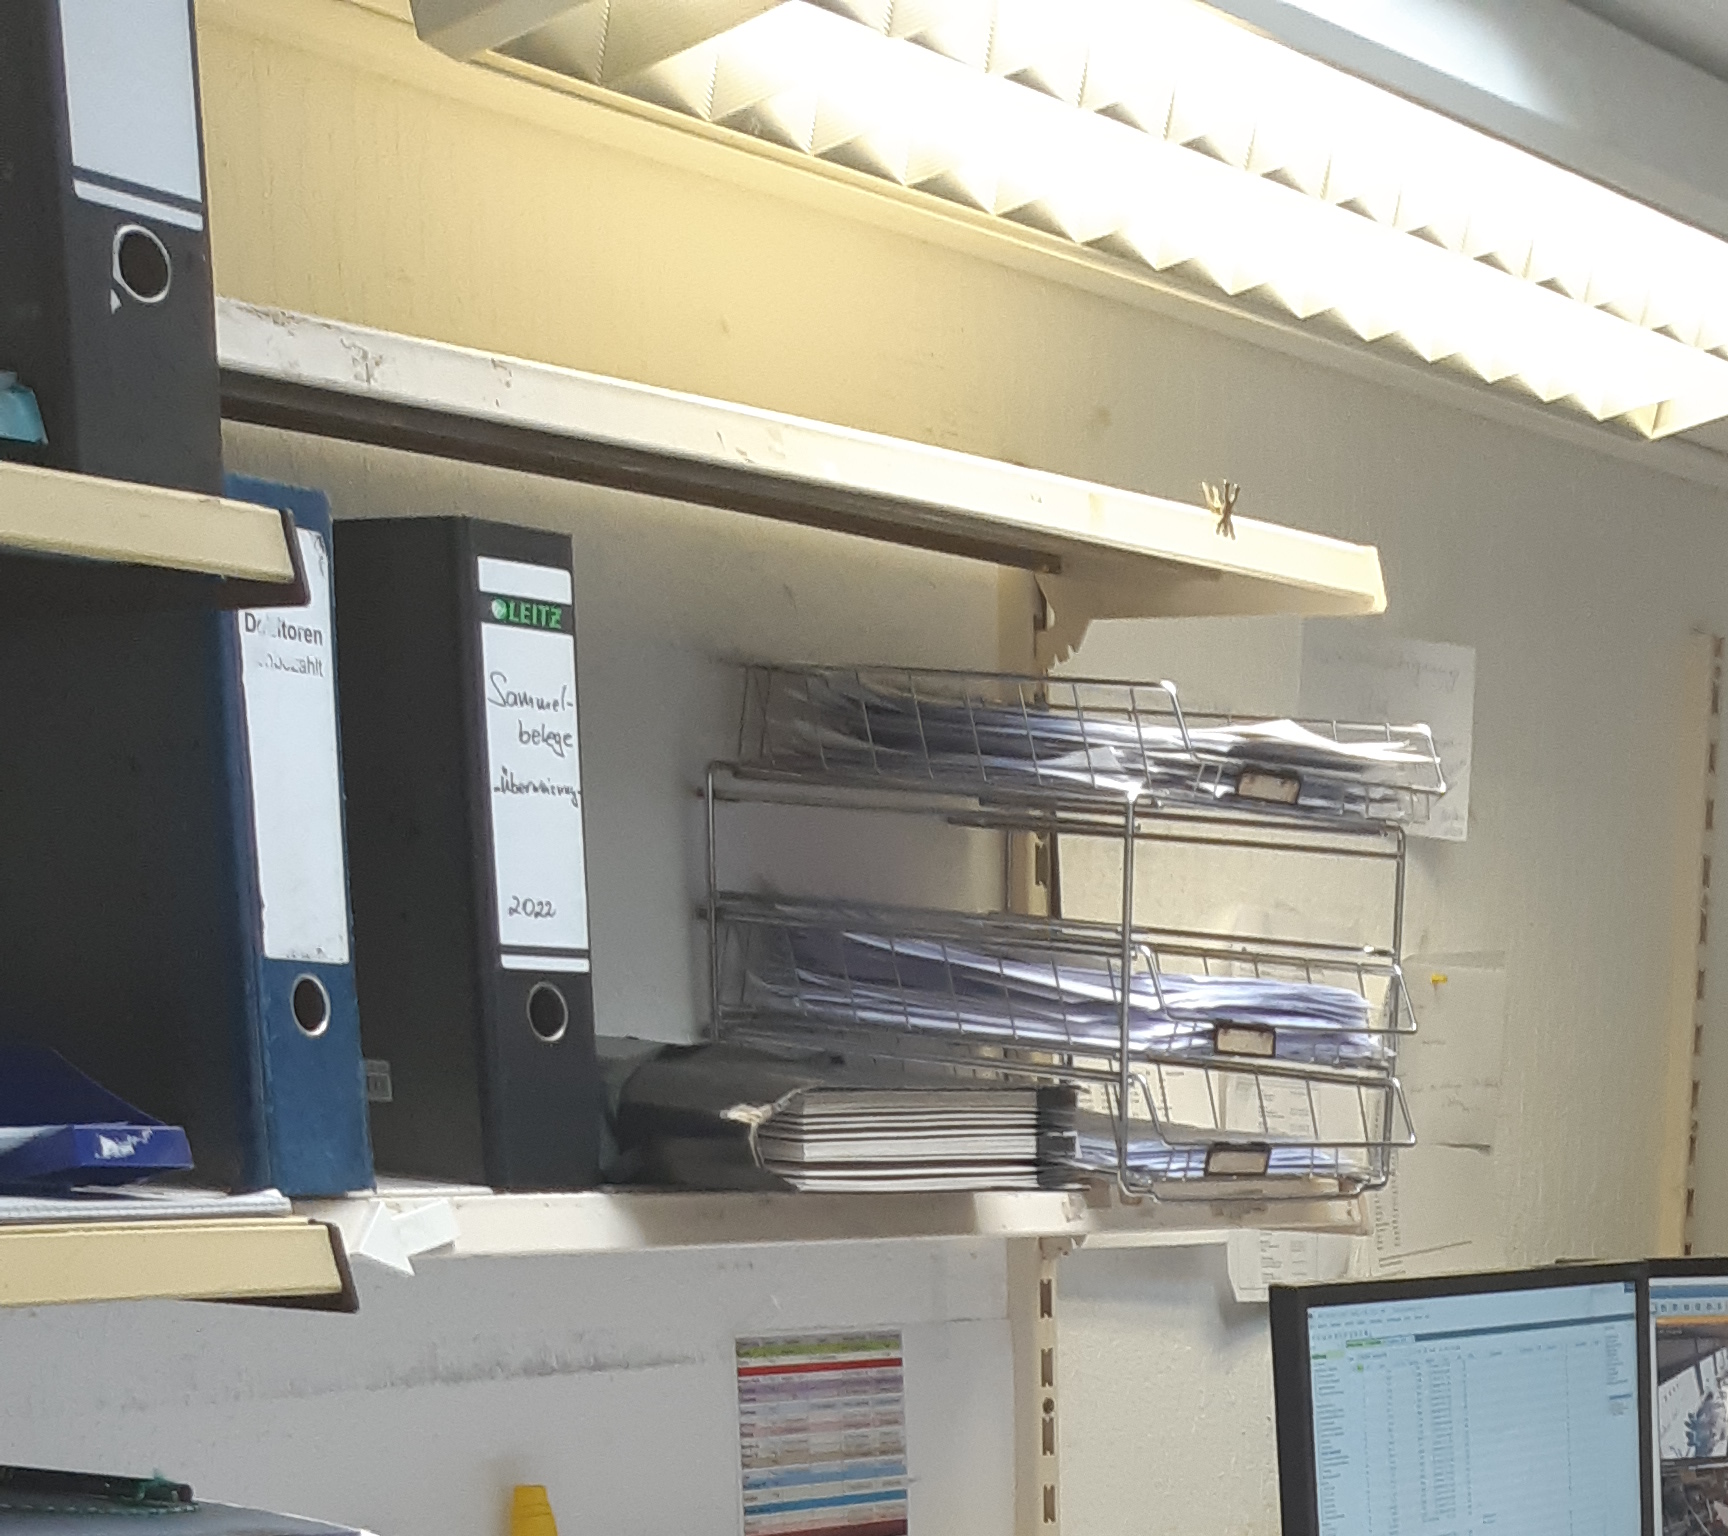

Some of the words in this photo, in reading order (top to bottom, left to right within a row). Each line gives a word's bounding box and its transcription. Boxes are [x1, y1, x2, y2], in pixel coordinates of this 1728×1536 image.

[508, 603, 563, 629] LEITZ
[487, 671, 574, 713] Sammel-
[517, 719, 574, 758] belege
[508, 895, 556, 919] 2022
